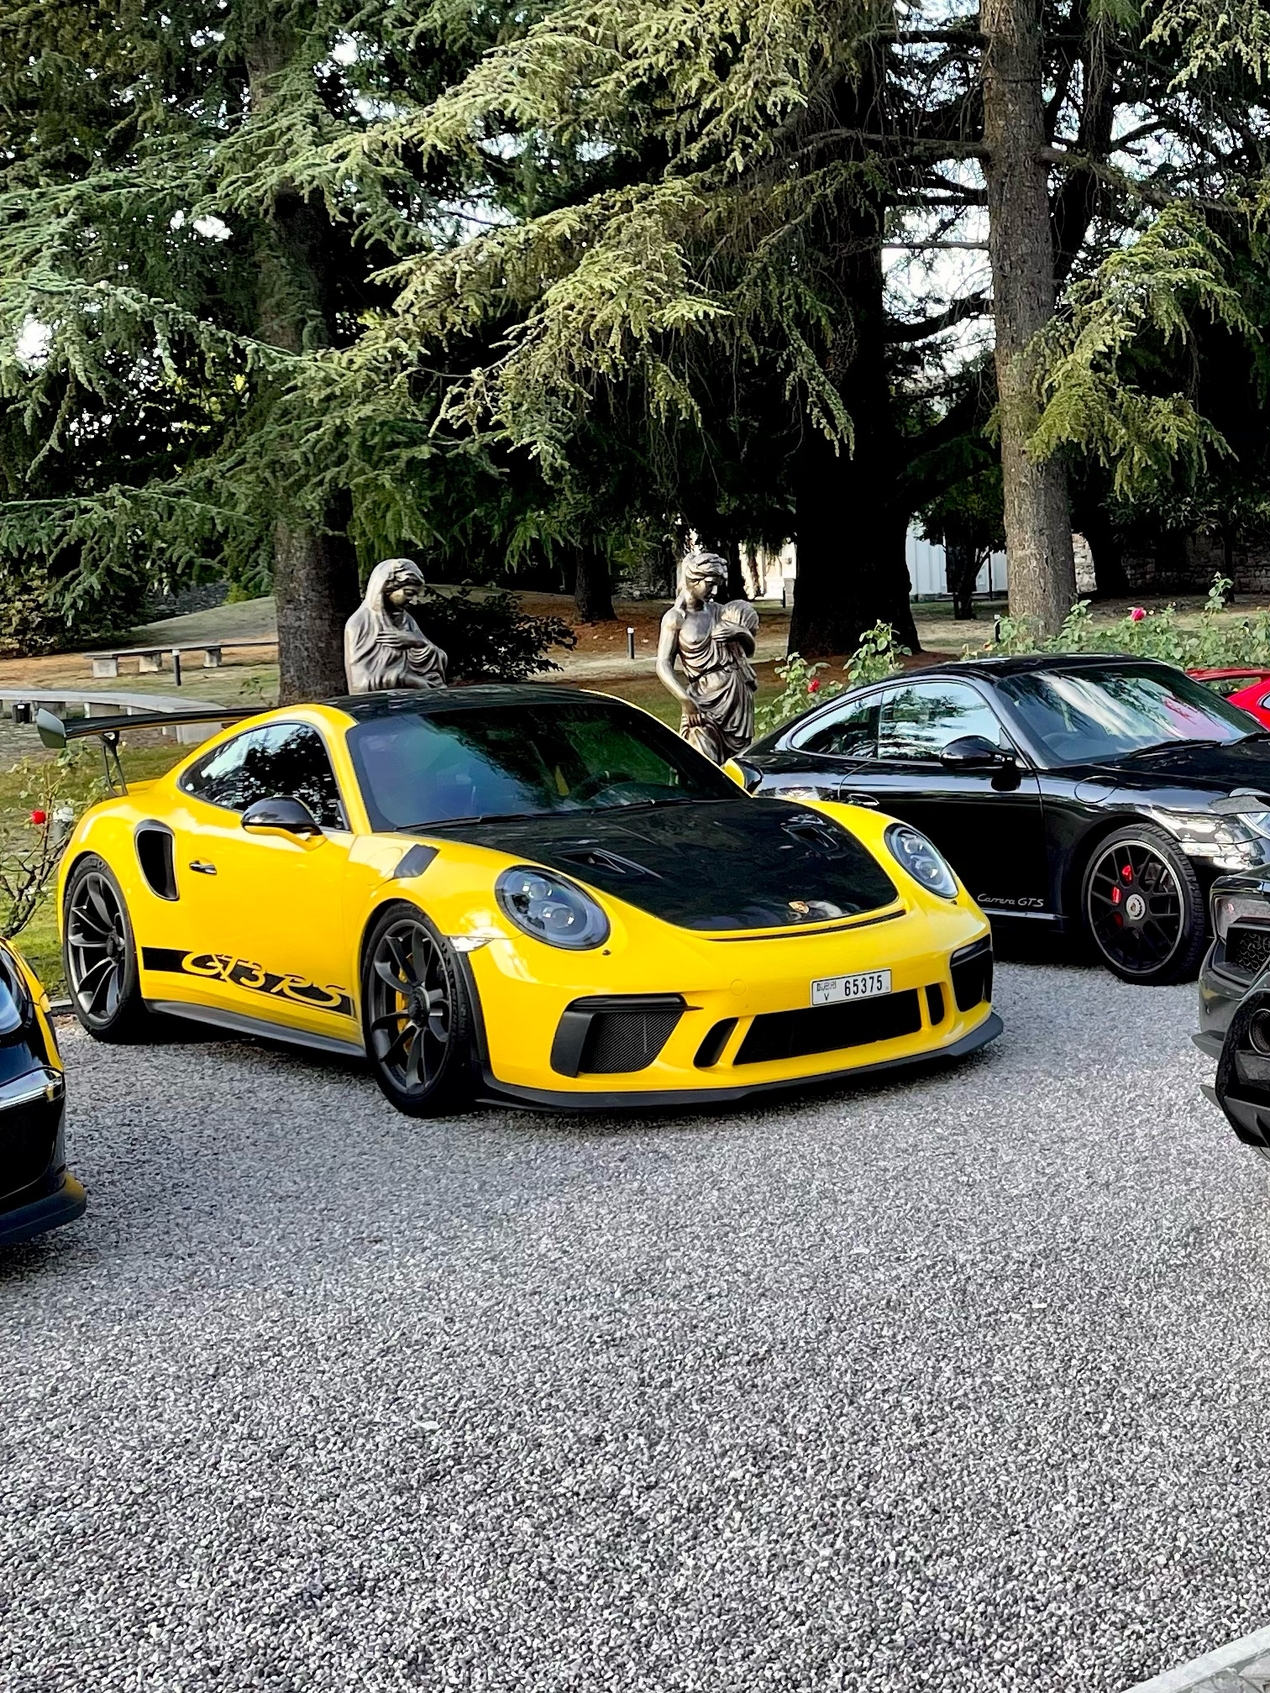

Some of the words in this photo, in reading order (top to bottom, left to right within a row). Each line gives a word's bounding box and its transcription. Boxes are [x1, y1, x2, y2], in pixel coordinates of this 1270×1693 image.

[977, 893, 1015, 905] Carrera
[1017, 897, 1044, 907] GTS
[181, 951, 266, 988] GT3
[270, 972, 345, 1008] RS
[844, 974, 883, 997] 65375
[823, 993, 830, 1001] V
